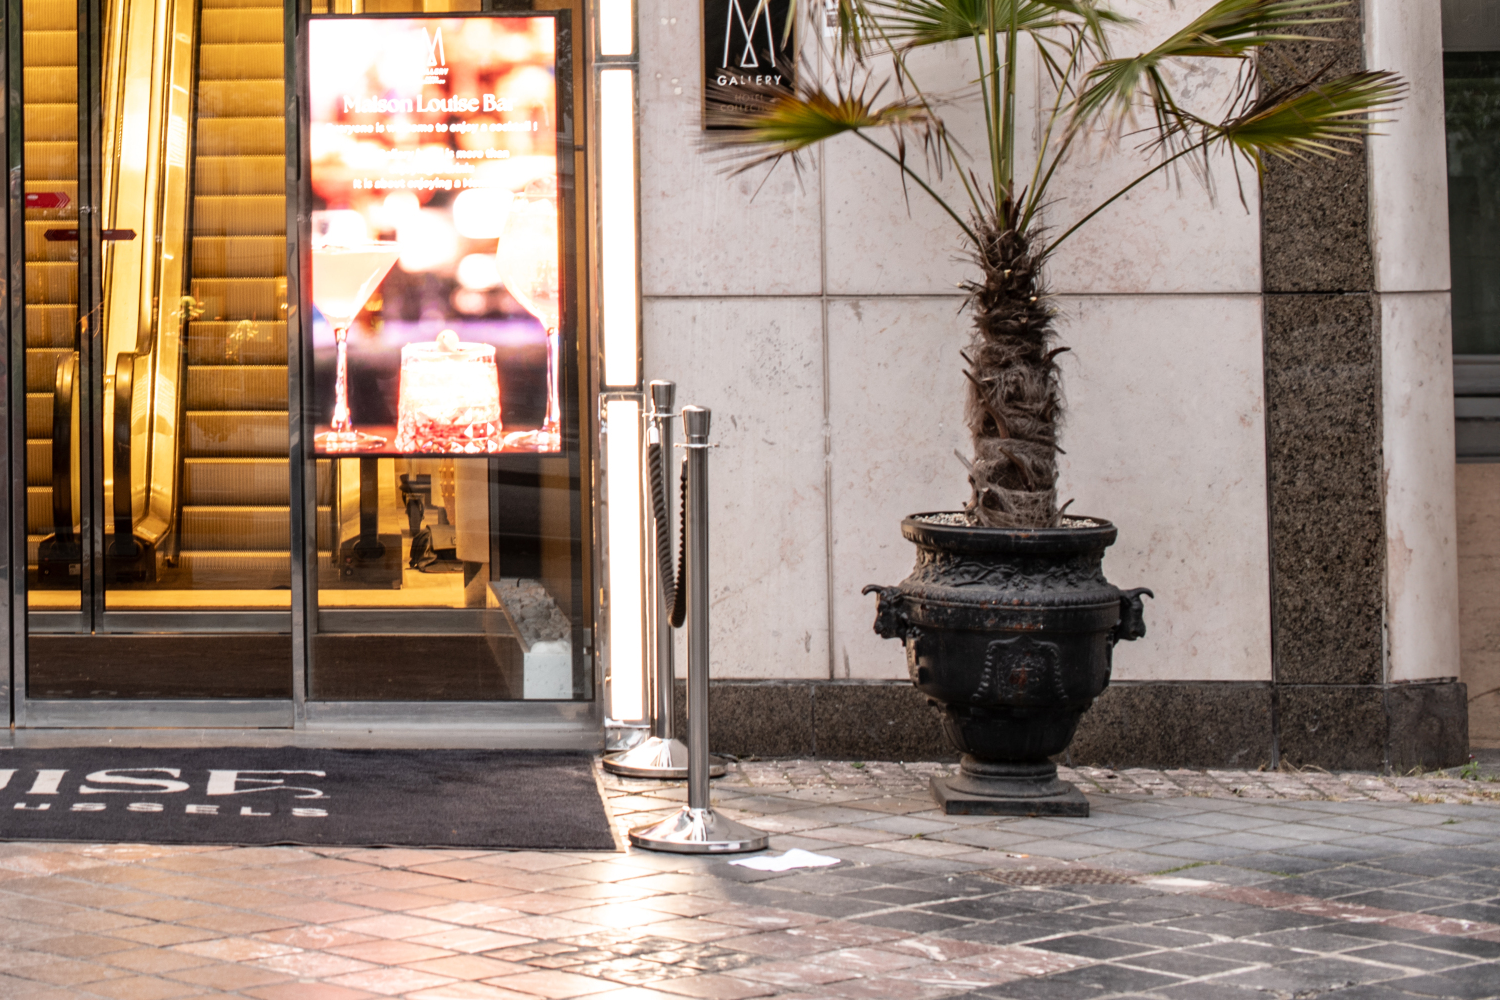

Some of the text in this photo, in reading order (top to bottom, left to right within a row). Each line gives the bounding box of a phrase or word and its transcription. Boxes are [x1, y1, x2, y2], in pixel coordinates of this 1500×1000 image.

[343, 94, 517, 113] Maison Louise Bar
[375, 122, 385, 132] is
[435, 123, 448, 132] to
[449, 122, 479, 134] enjoy
[456, 149, 484, 159] more
[485, 147, 510, 158] than
[353, 179, 363, 189] It
[364, 178, 373, 188] is
[374, 178, 406, 189] about
[407, 177, 452, 190] enjoying
